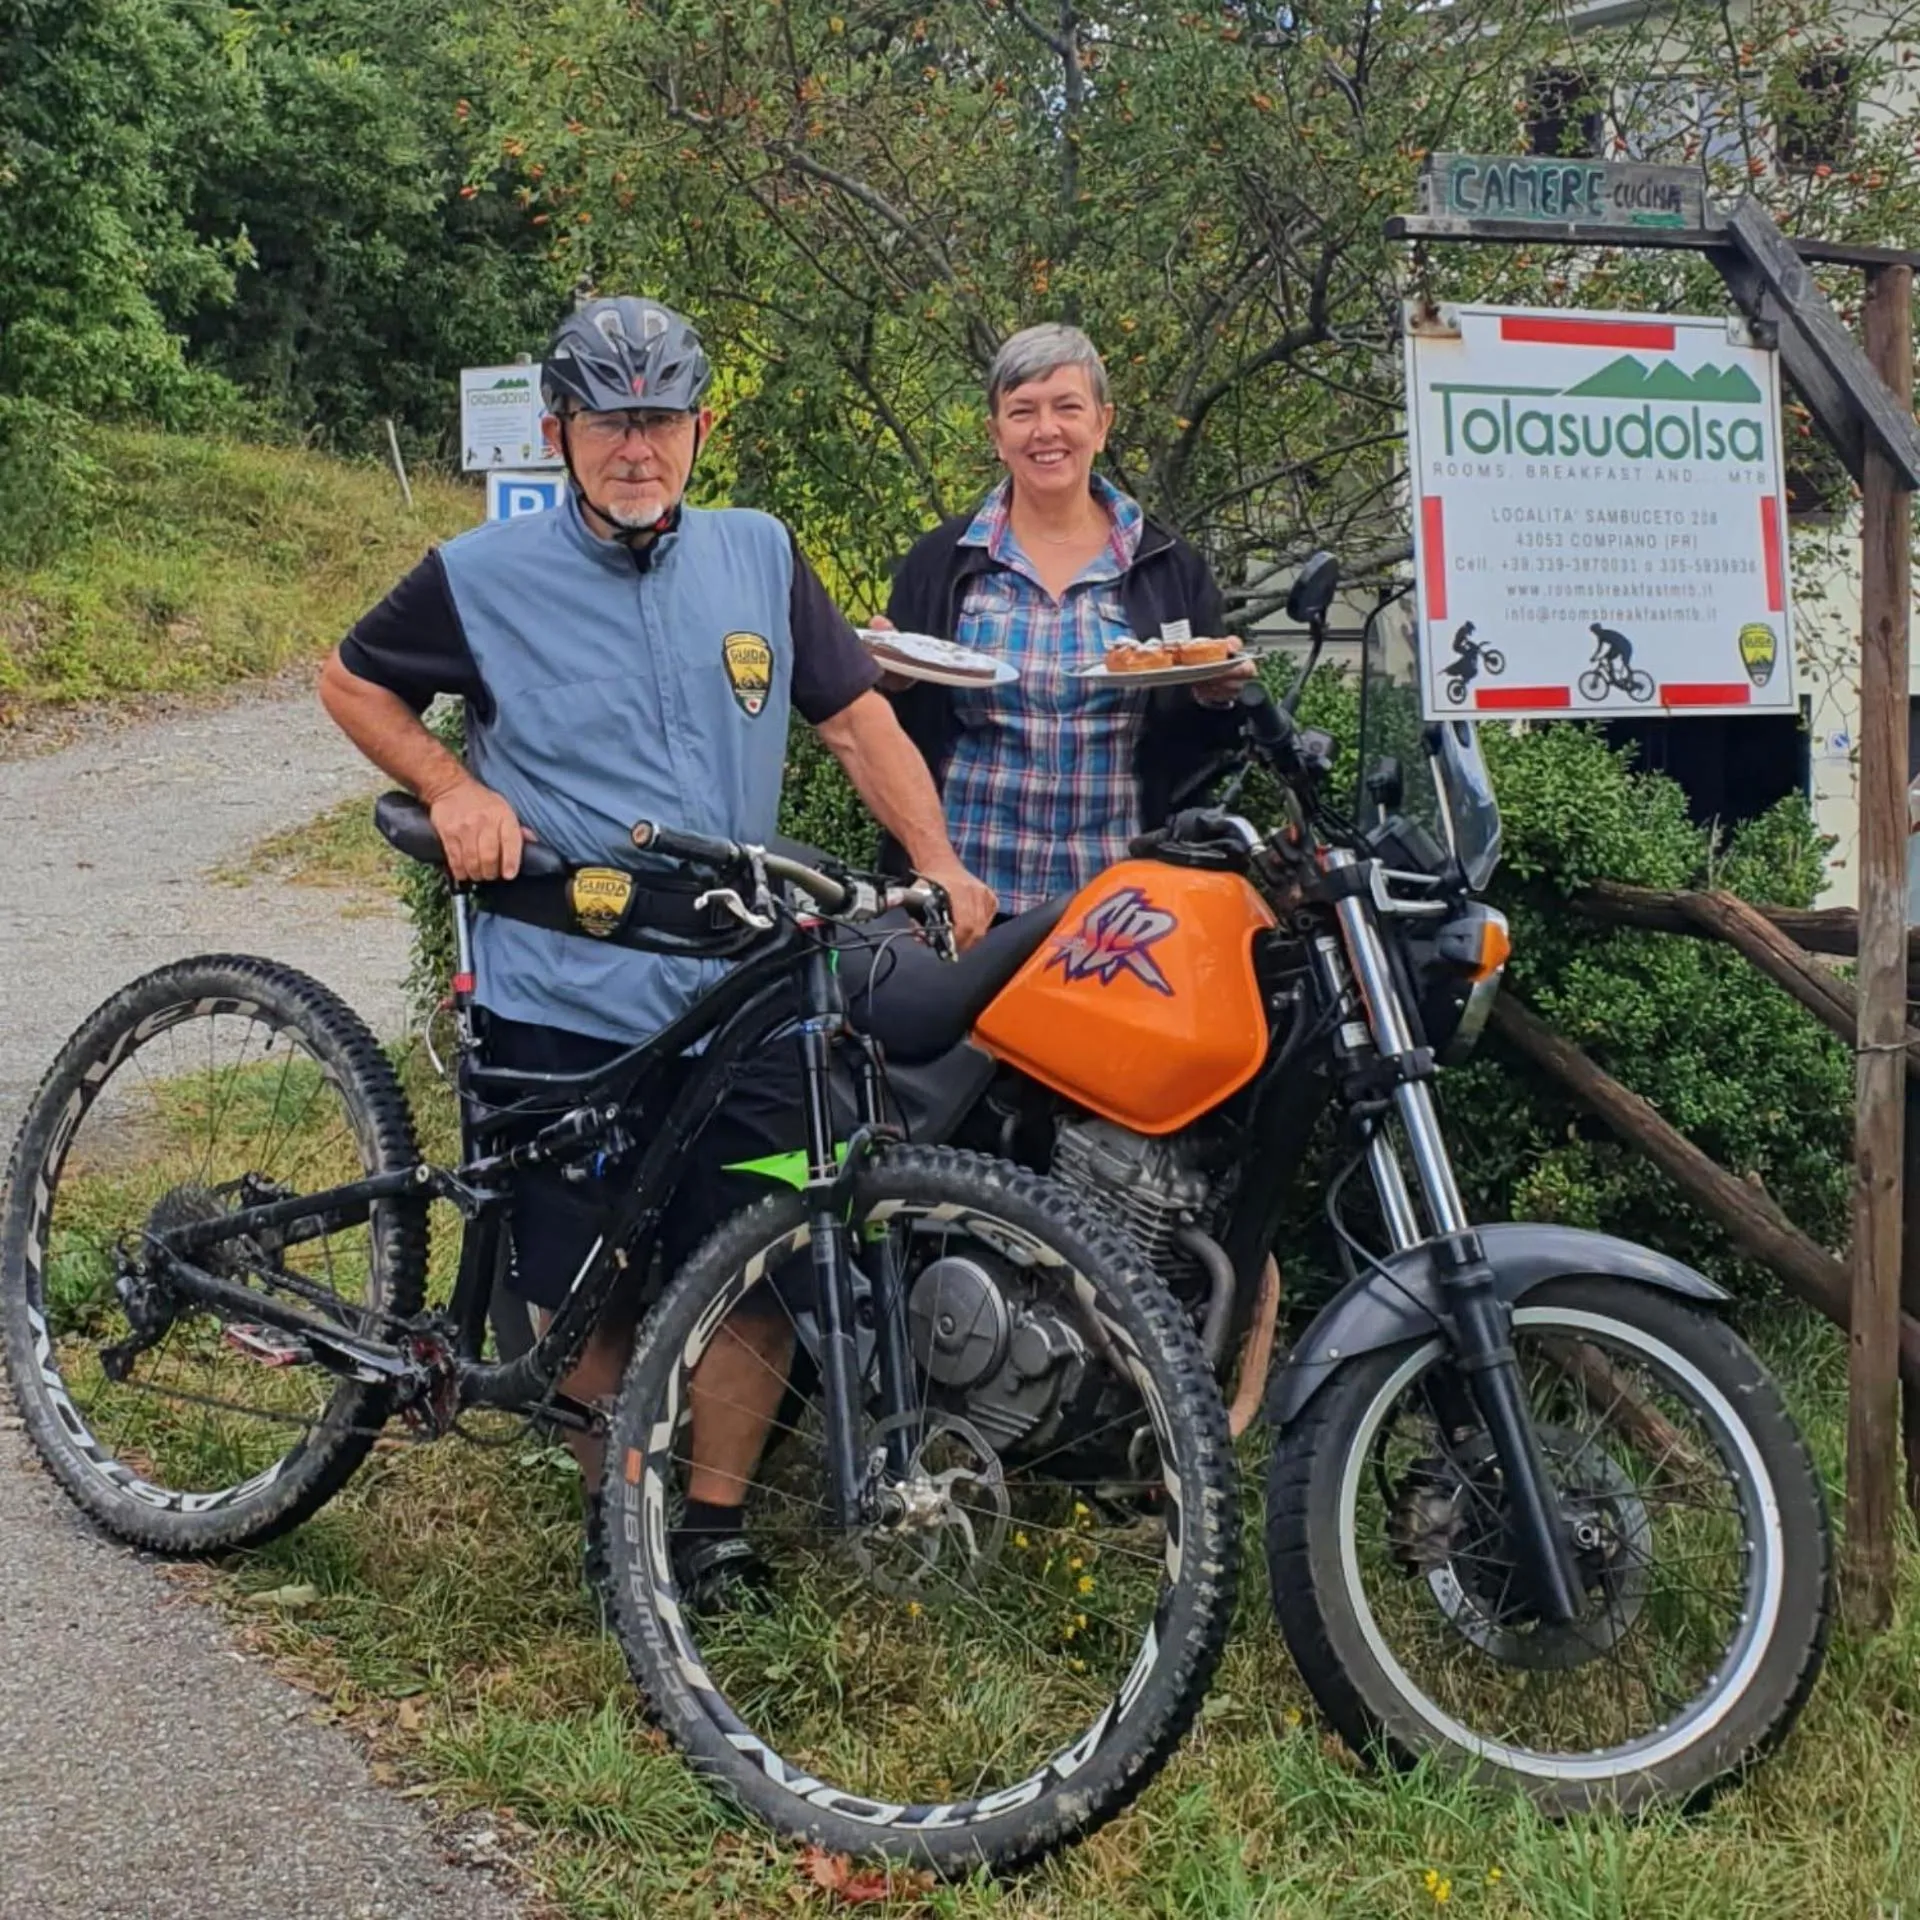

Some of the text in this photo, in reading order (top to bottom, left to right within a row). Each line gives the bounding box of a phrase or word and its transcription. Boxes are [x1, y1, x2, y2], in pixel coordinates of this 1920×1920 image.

[1454, 165, 1606, 216] CAMERE
[1430, 383, 1763, 461] Tolasudolsa
[1526, 464, 1642, 481] BREAKFAST
[1728, 471, 1765, 485] MTB
[509, 487, 545, 519] P
[1586, 508, 1685, 525] SAMBUCETO
[1570, 532, 1656, 549] COMPIANO
[577, 880, 627, 896] GUIDA
